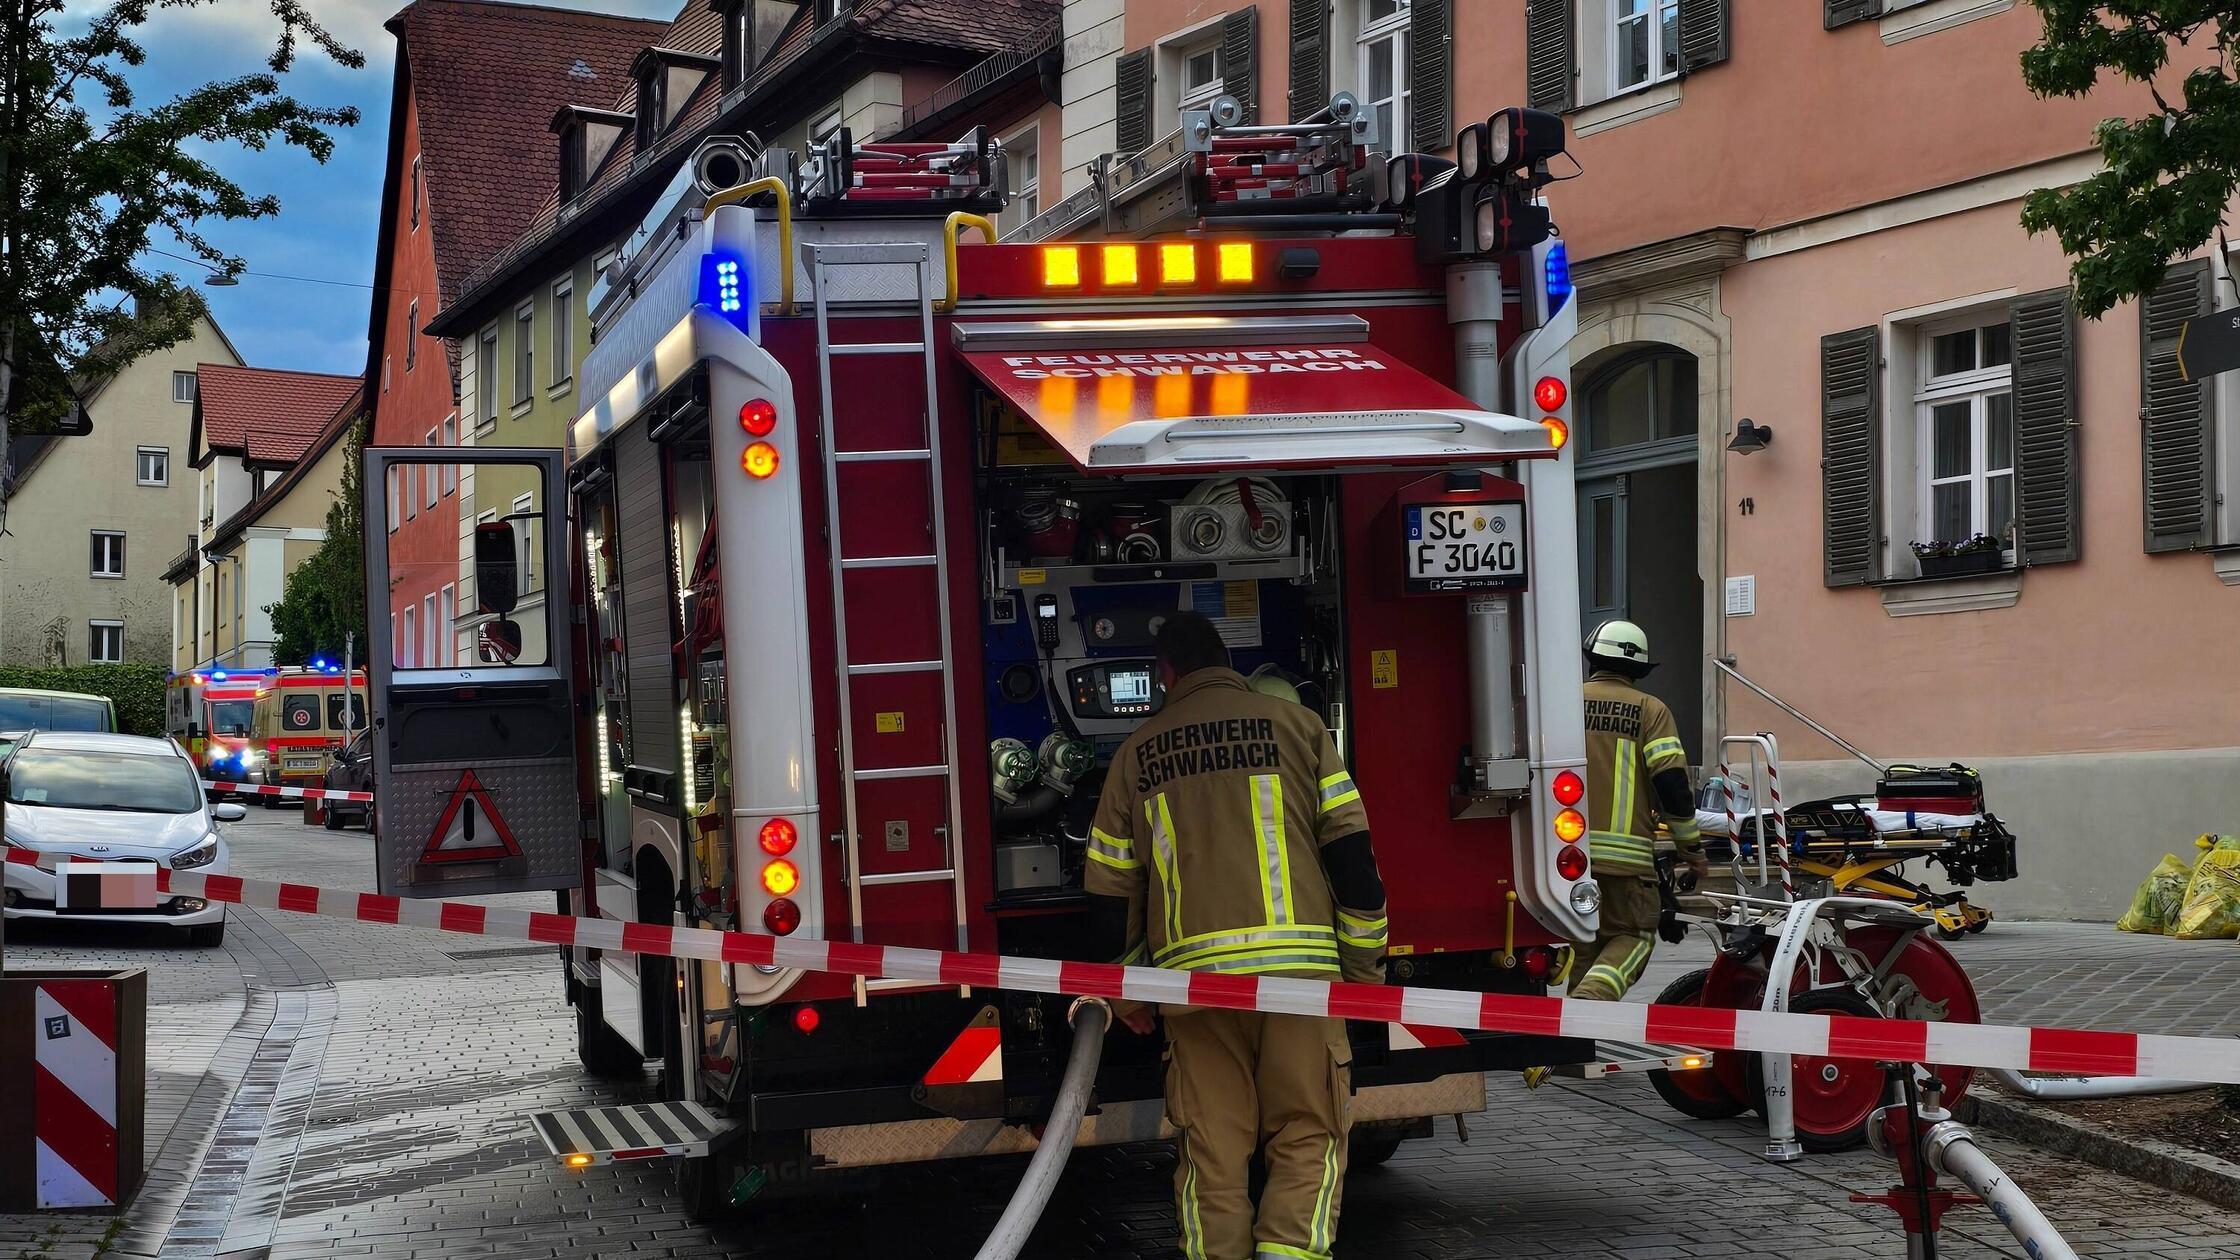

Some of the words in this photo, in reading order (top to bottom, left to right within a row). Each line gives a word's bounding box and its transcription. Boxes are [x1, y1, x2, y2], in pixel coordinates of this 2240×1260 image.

[1001, 348, 1362, 367] FEUERWEHR
[1012, 359, 1388, 379] SCHWABACH
[1738, 497, 1755, 516] 14
[1429, 510, 1467, 540] SC
[1417, 543, 1436, 575] F
[1444, 541, 1516, 573] 3040
[1584, 699, 1642, 720] RWEHR
[1136, 718, 1274, 769] FEUERWEHR
[1137, 742, 1281, 793] SCHWABACH
